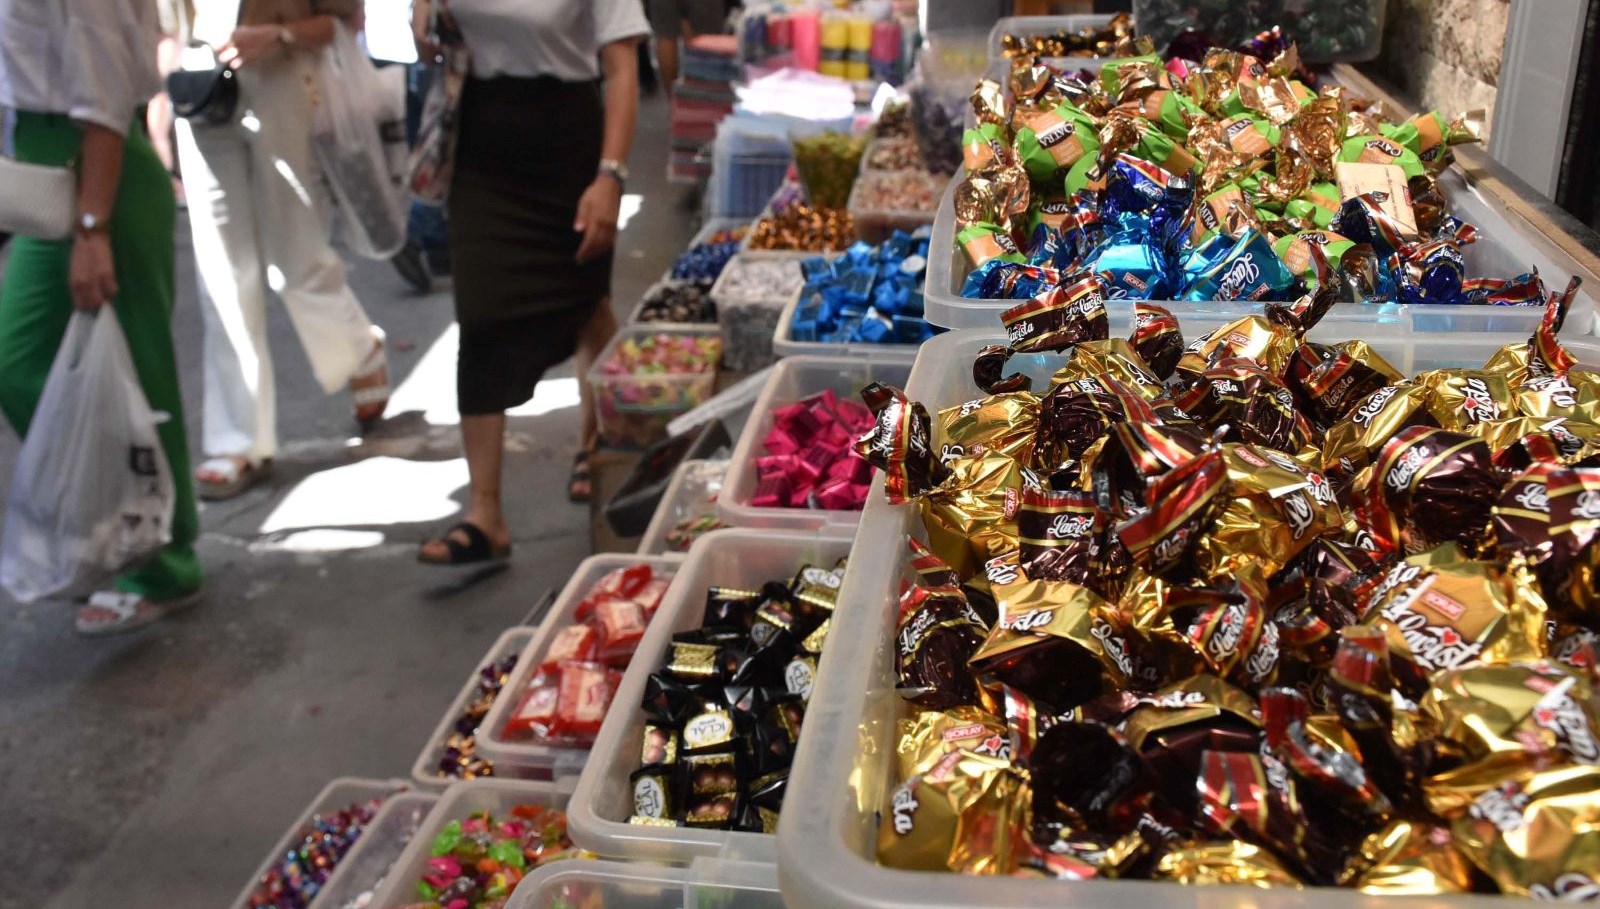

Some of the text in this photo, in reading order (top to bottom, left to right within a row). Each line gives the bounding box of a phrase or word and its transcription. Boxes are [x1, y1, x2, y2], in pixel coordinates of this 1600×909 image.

[1227, 118, 1253, 137] ATRA
[1124, 273, 1147, 291] SORAY
[1230, 333, 1250, 346] SORA
[1352, 386, 1399, 429] Lavis
[1387, 445, 1430, 491] Lavista
[1047, 515, 1095, 538] Lavist
